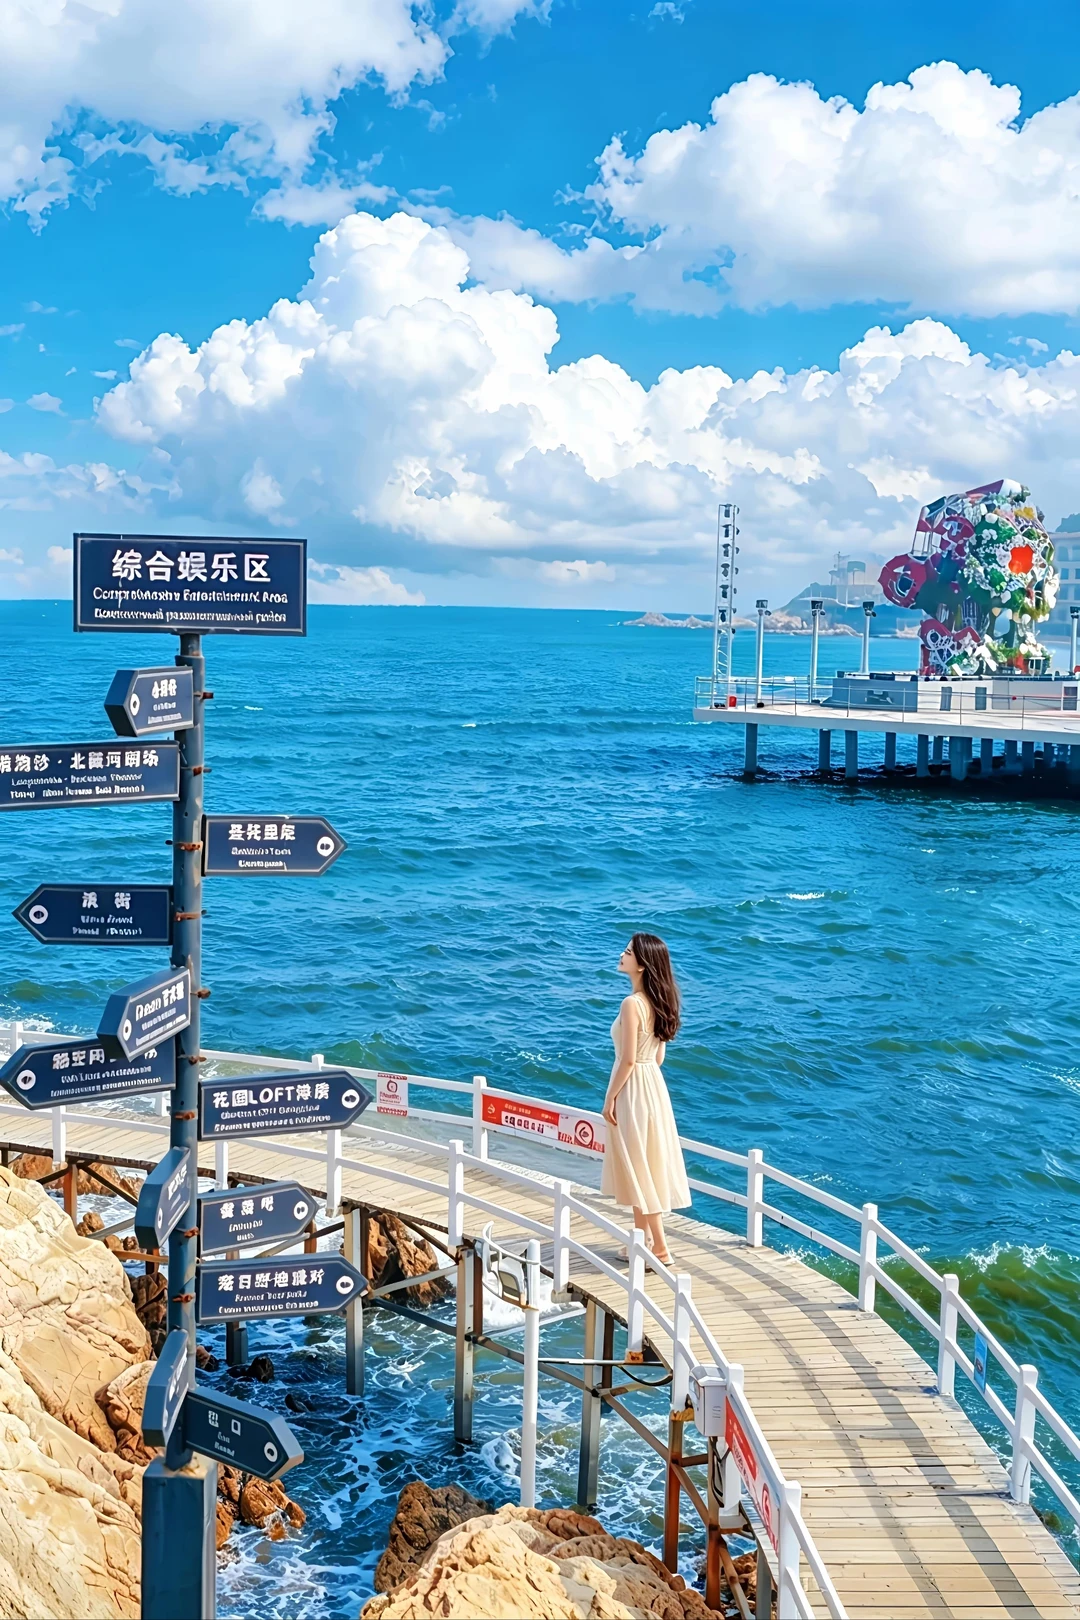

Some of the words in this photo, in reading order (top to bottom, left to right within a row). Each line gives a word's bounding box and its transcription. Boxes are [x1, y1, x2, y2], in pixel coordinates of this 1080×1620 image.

[112, 549, 271, 582] 综合娱乐区
